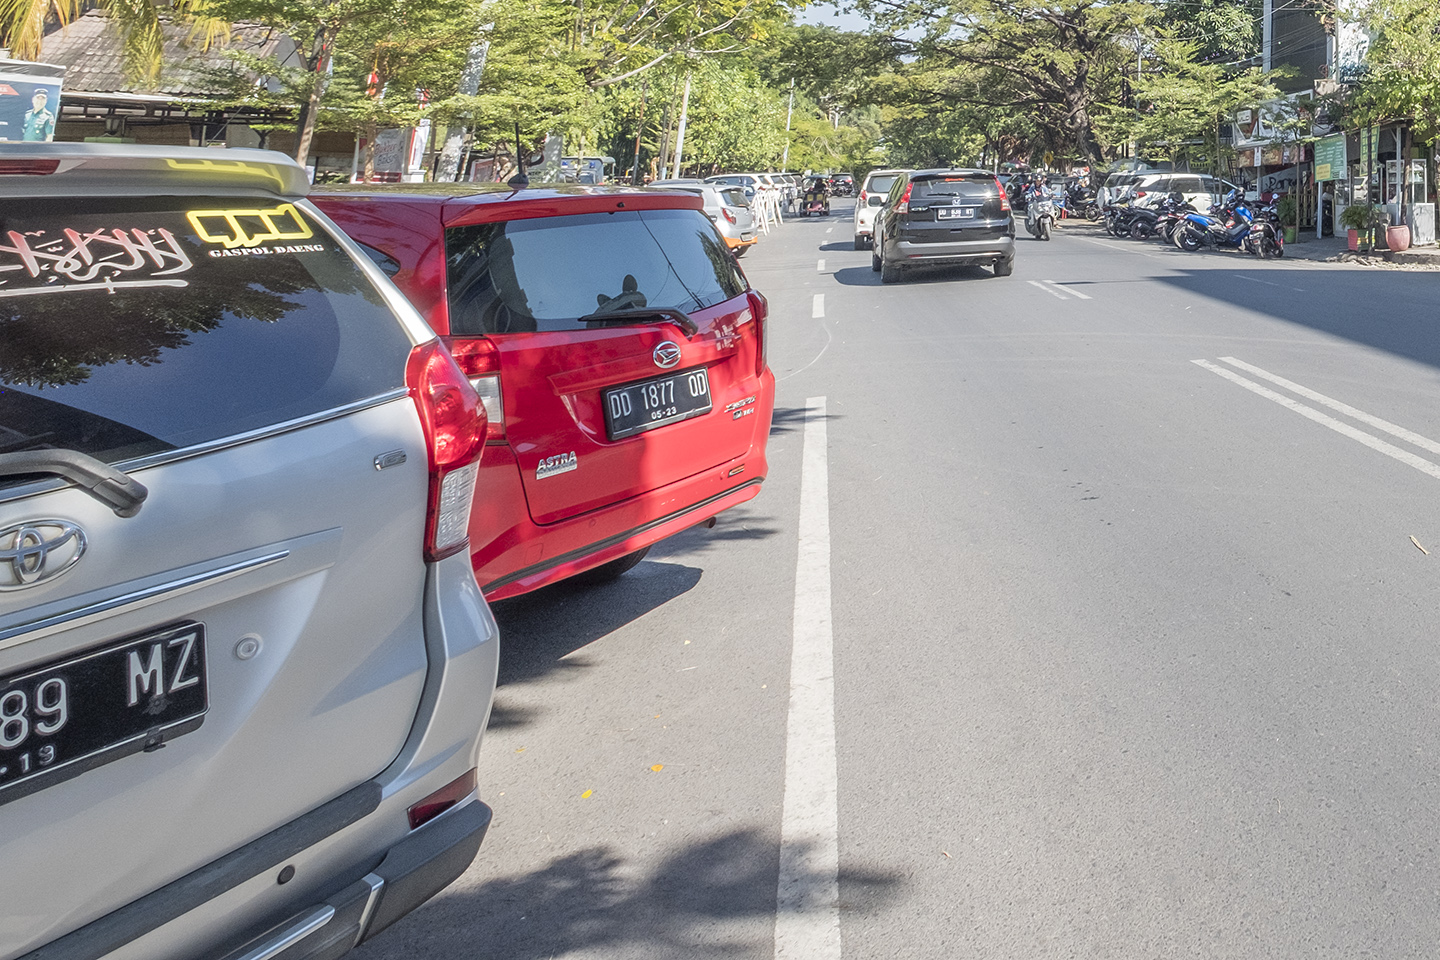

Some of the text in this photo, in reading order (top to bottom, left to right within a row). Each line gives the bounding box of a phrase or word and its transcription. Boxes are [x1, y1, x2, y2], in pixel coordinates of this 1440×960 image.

[209, 244, 325, 258] GASPOL DAENG
[610, 392, 632, 420] DD
[641, 381, 675, 410] 1877
[537, 450, 577, 471] ASTRA
[127, 632, 199, 708] MZ
